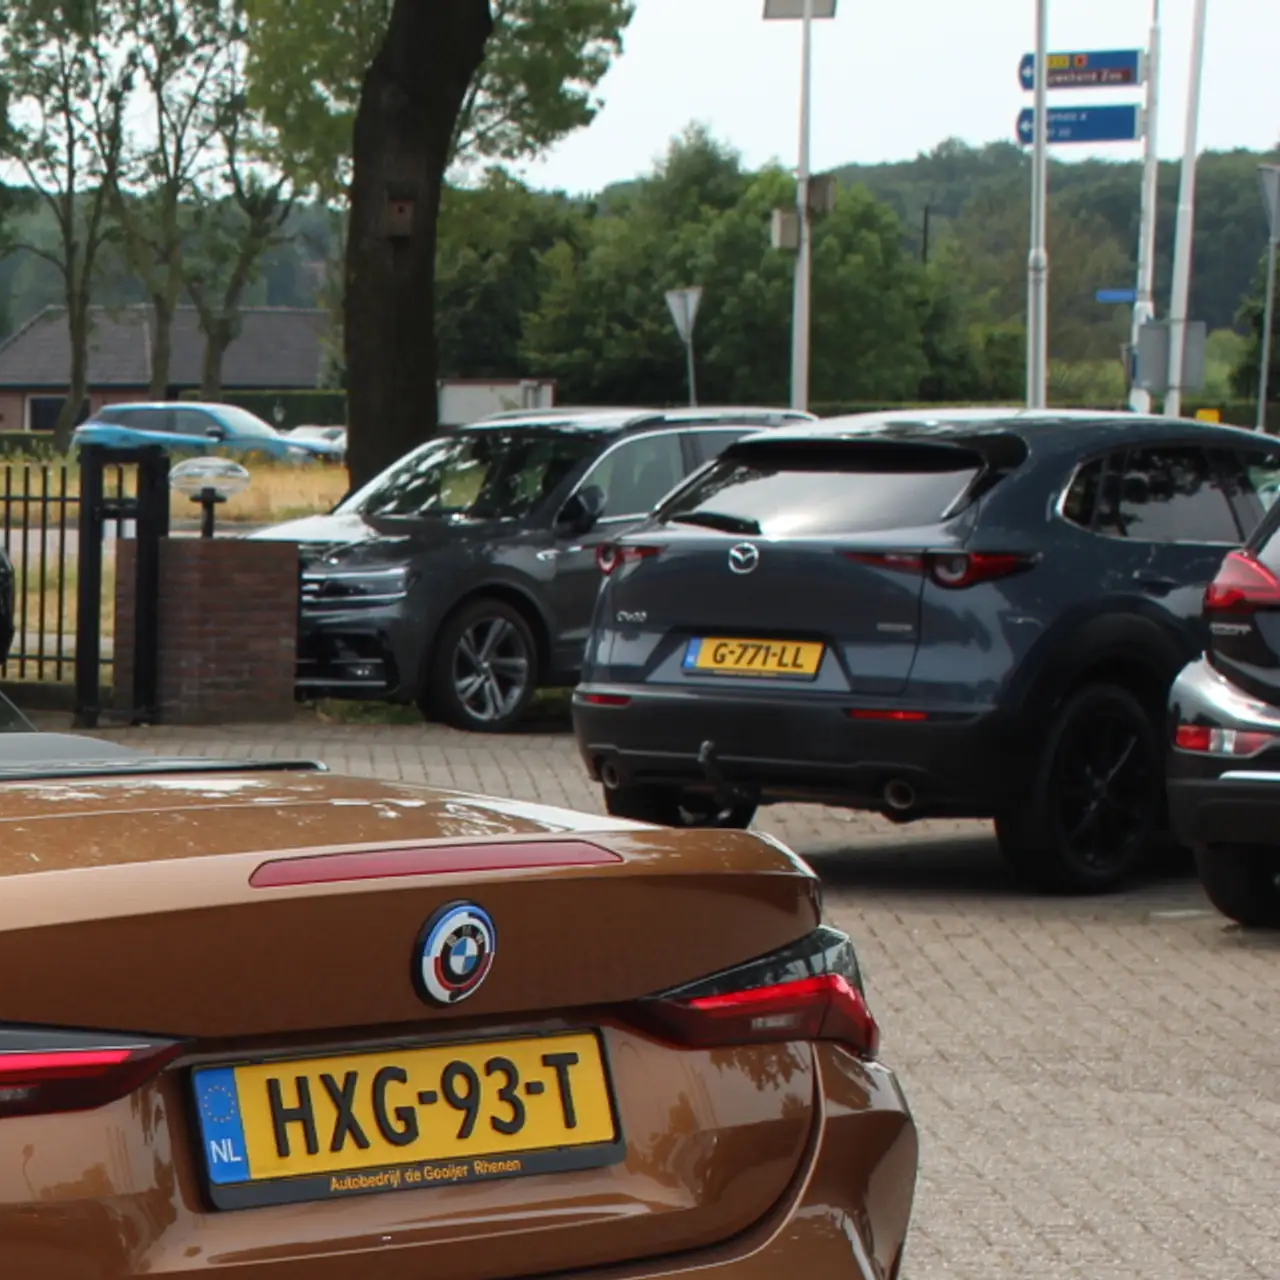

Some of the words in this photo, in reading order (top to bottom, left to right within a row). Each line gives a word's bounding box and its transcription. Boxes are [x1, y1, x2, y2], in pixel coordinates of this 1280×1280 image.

[712, 642, 804, 669] G-771-LL
[266, 1052, 579, 1158] HXG-93-T
[210, 1138, 242, 1164] NL
[404, 1167, 422, 1183] de
[424, 1163, 469, 1181] Gooijer
[474, 1159, 521, 1175] Rhenen
